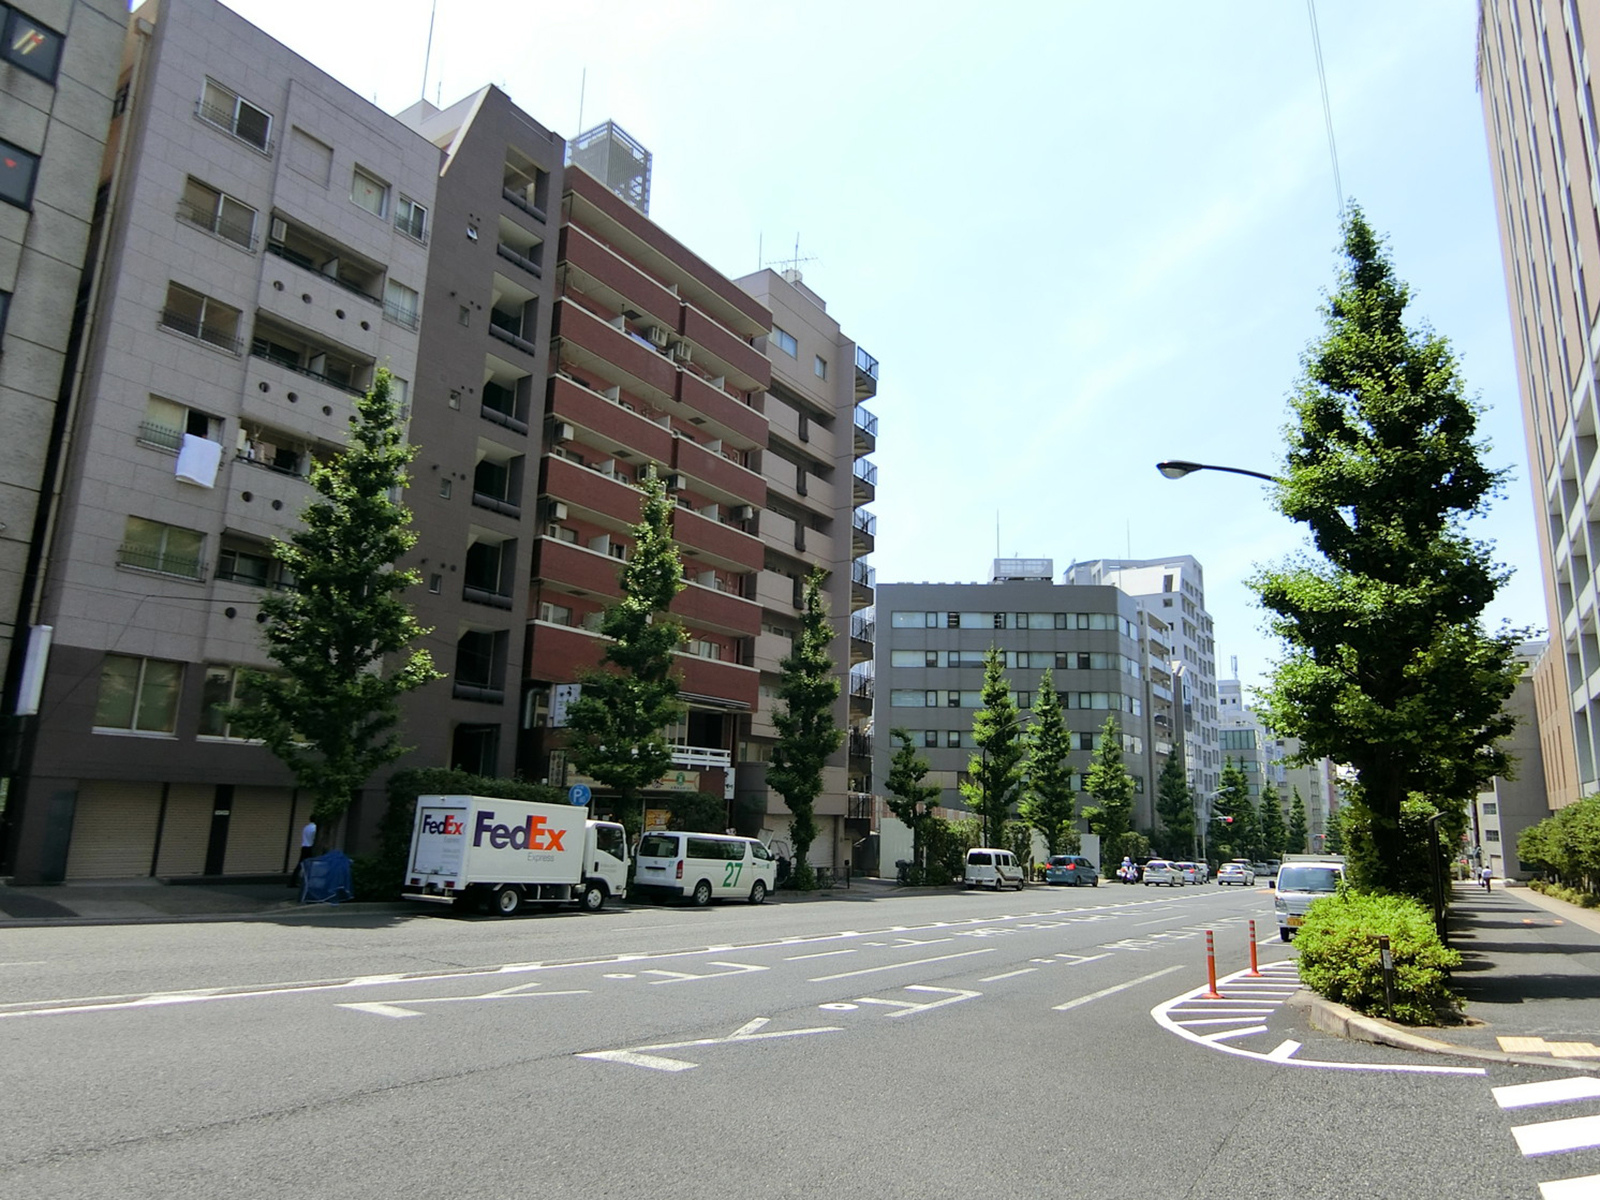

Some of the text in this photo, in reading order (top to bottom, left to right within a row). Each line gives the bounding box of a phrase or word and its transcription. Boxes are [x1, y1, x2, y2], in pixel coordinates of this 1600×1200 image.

[573, 789, 583, 803] P
[422, 814, 464, 835] FedEx
[473, 810, 567, 852] FedEx
[527, 852, 555, 863] Express
[722, 861, 743, 888] 27
